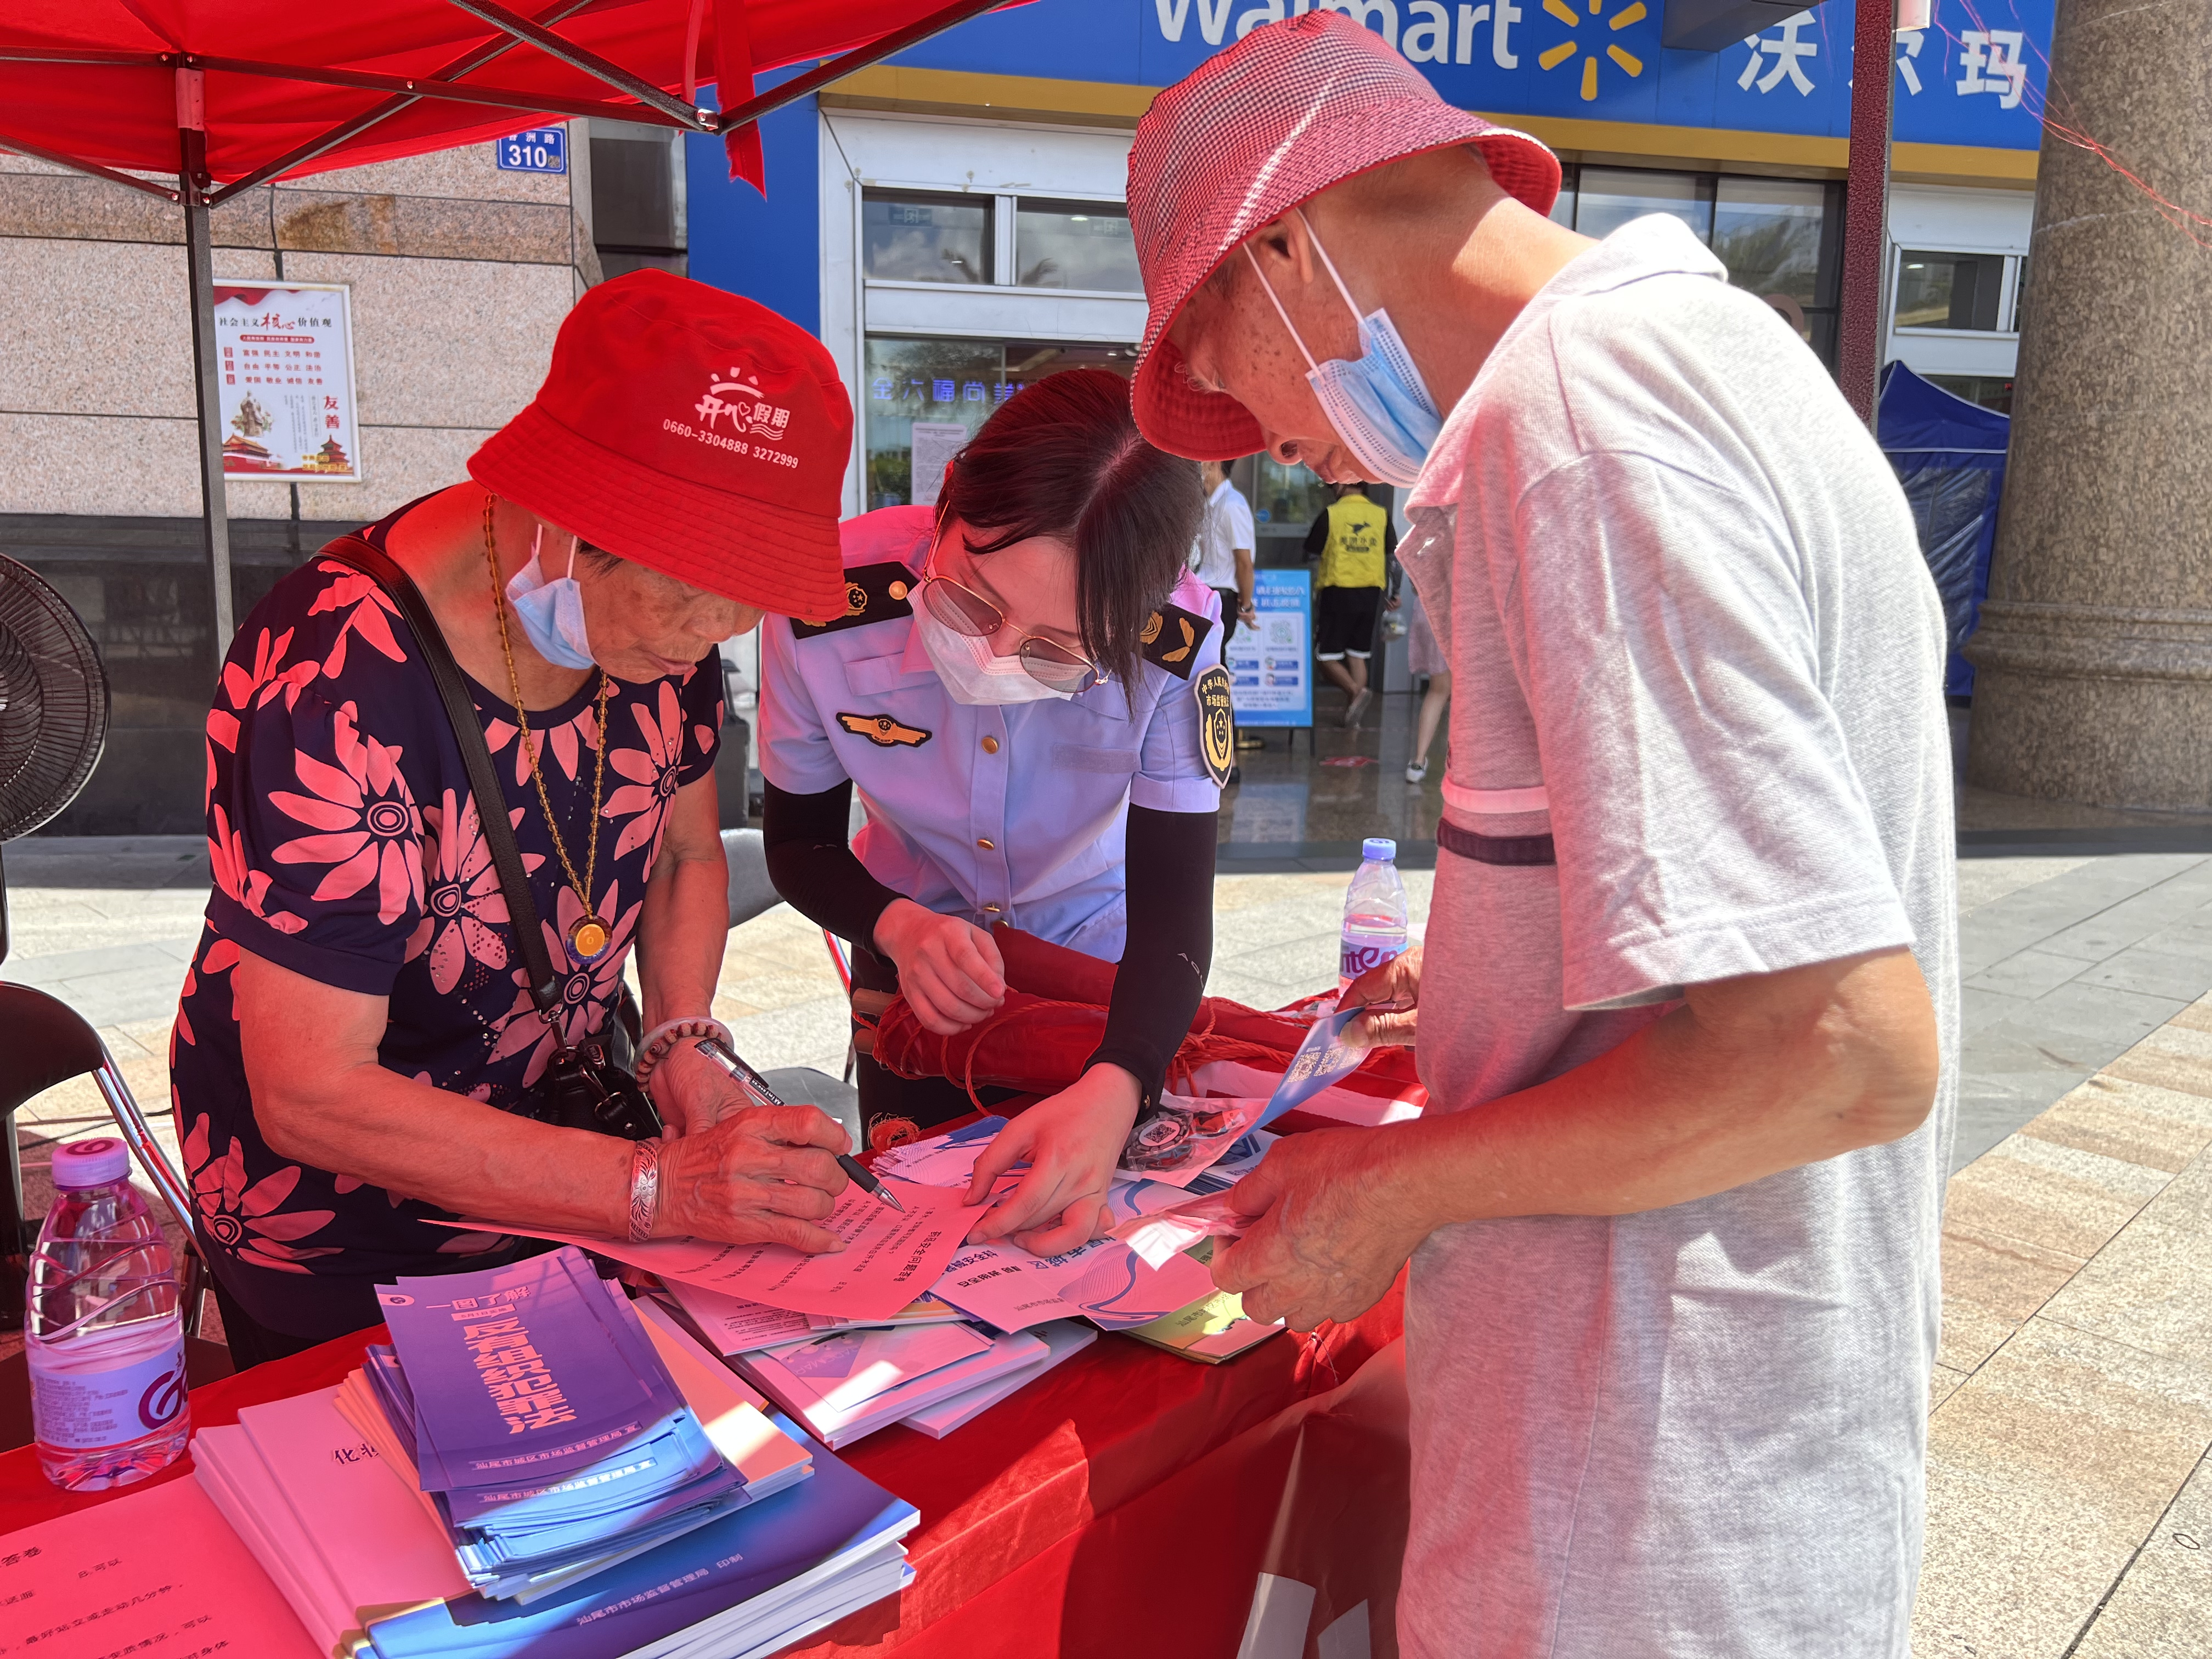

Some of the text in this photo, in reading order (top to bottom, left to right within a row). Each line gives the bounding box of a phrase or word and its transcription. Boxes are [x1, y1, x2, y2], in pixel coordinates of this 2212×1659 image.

[1154, 0, 1521, 69] Wamart
[509, 145, 548, 168] 310
[219, 312, 332, 330] 社会主义核心价值观
[323, 395, 340, 429] 友善
[695, 394, 791, 432] 开心假期
[663, 419, 799, 469] 0660-3304888 3272999
[893, 1231, 942, 1282] 药品安全问题答卷
[426, 1286, 532, 1311] 一图了解
[463, 1317, 578, 1434] 反有组织犯罪法
[475, 1430, 623, 1469] 汕尾市城区市场监督管理局
[483, 1465, 636, 1502] 汕尾市城区市场监督管理局
[576, 1553, 743, 1626] 汕尾市市场监督管理局 印制
